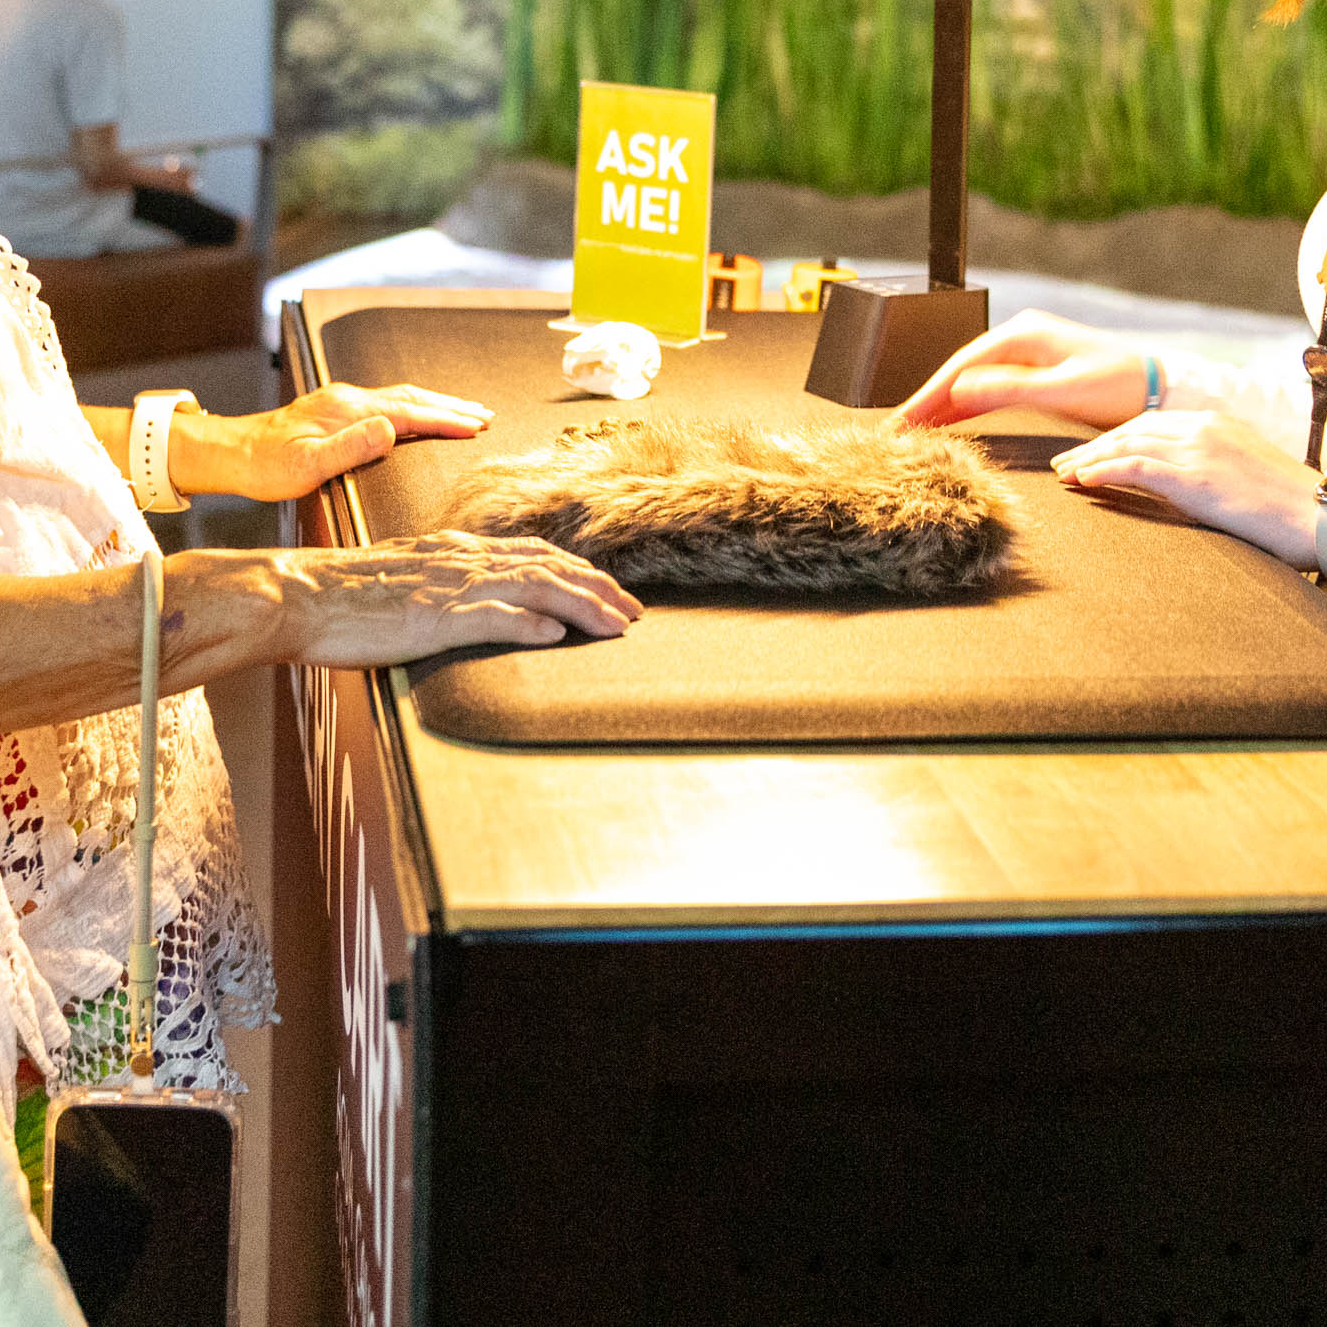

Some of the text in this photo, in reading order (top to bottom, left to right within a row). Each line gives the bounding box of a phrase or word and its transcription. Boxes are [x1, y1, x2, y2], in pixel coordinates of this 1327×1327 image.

[595, 129, 690, 184] ASK
[601, 180, 681, 235] ME!
[339, 751, 403, 1327] CART
